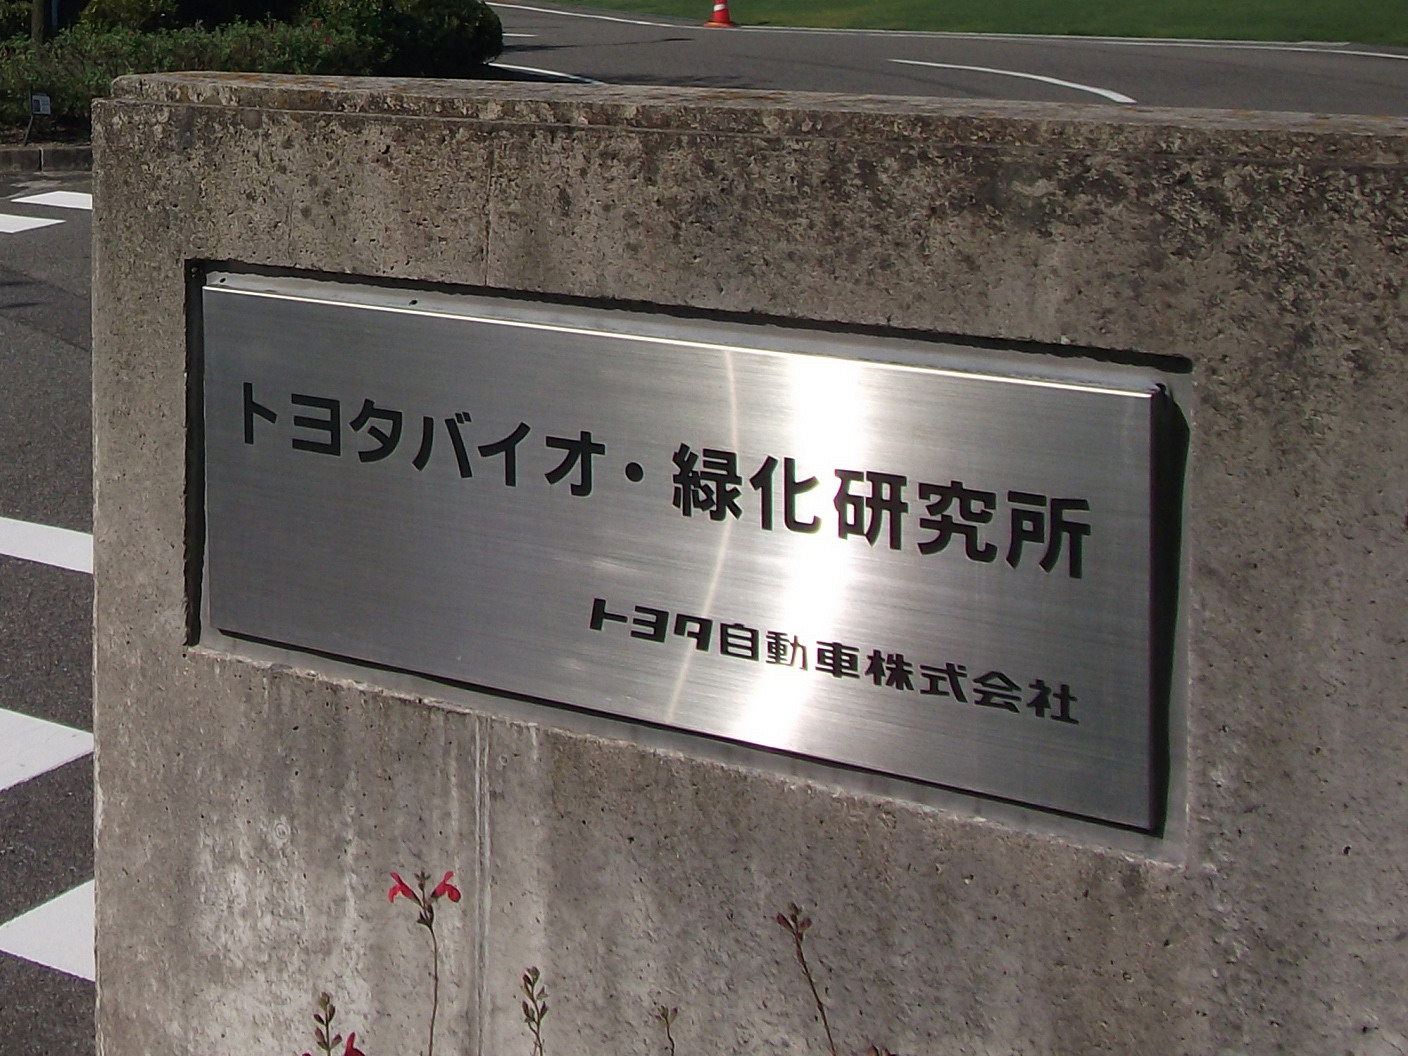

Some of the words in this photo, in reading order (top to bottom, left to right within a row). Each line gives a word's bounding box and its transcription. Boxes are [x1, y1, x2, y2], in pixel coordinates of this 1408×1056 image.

[242, 381, 1092, 580] トヨタバイオ・緑化研究所
[589, 597, 1080, 725] トヨタ自動車株式会社
